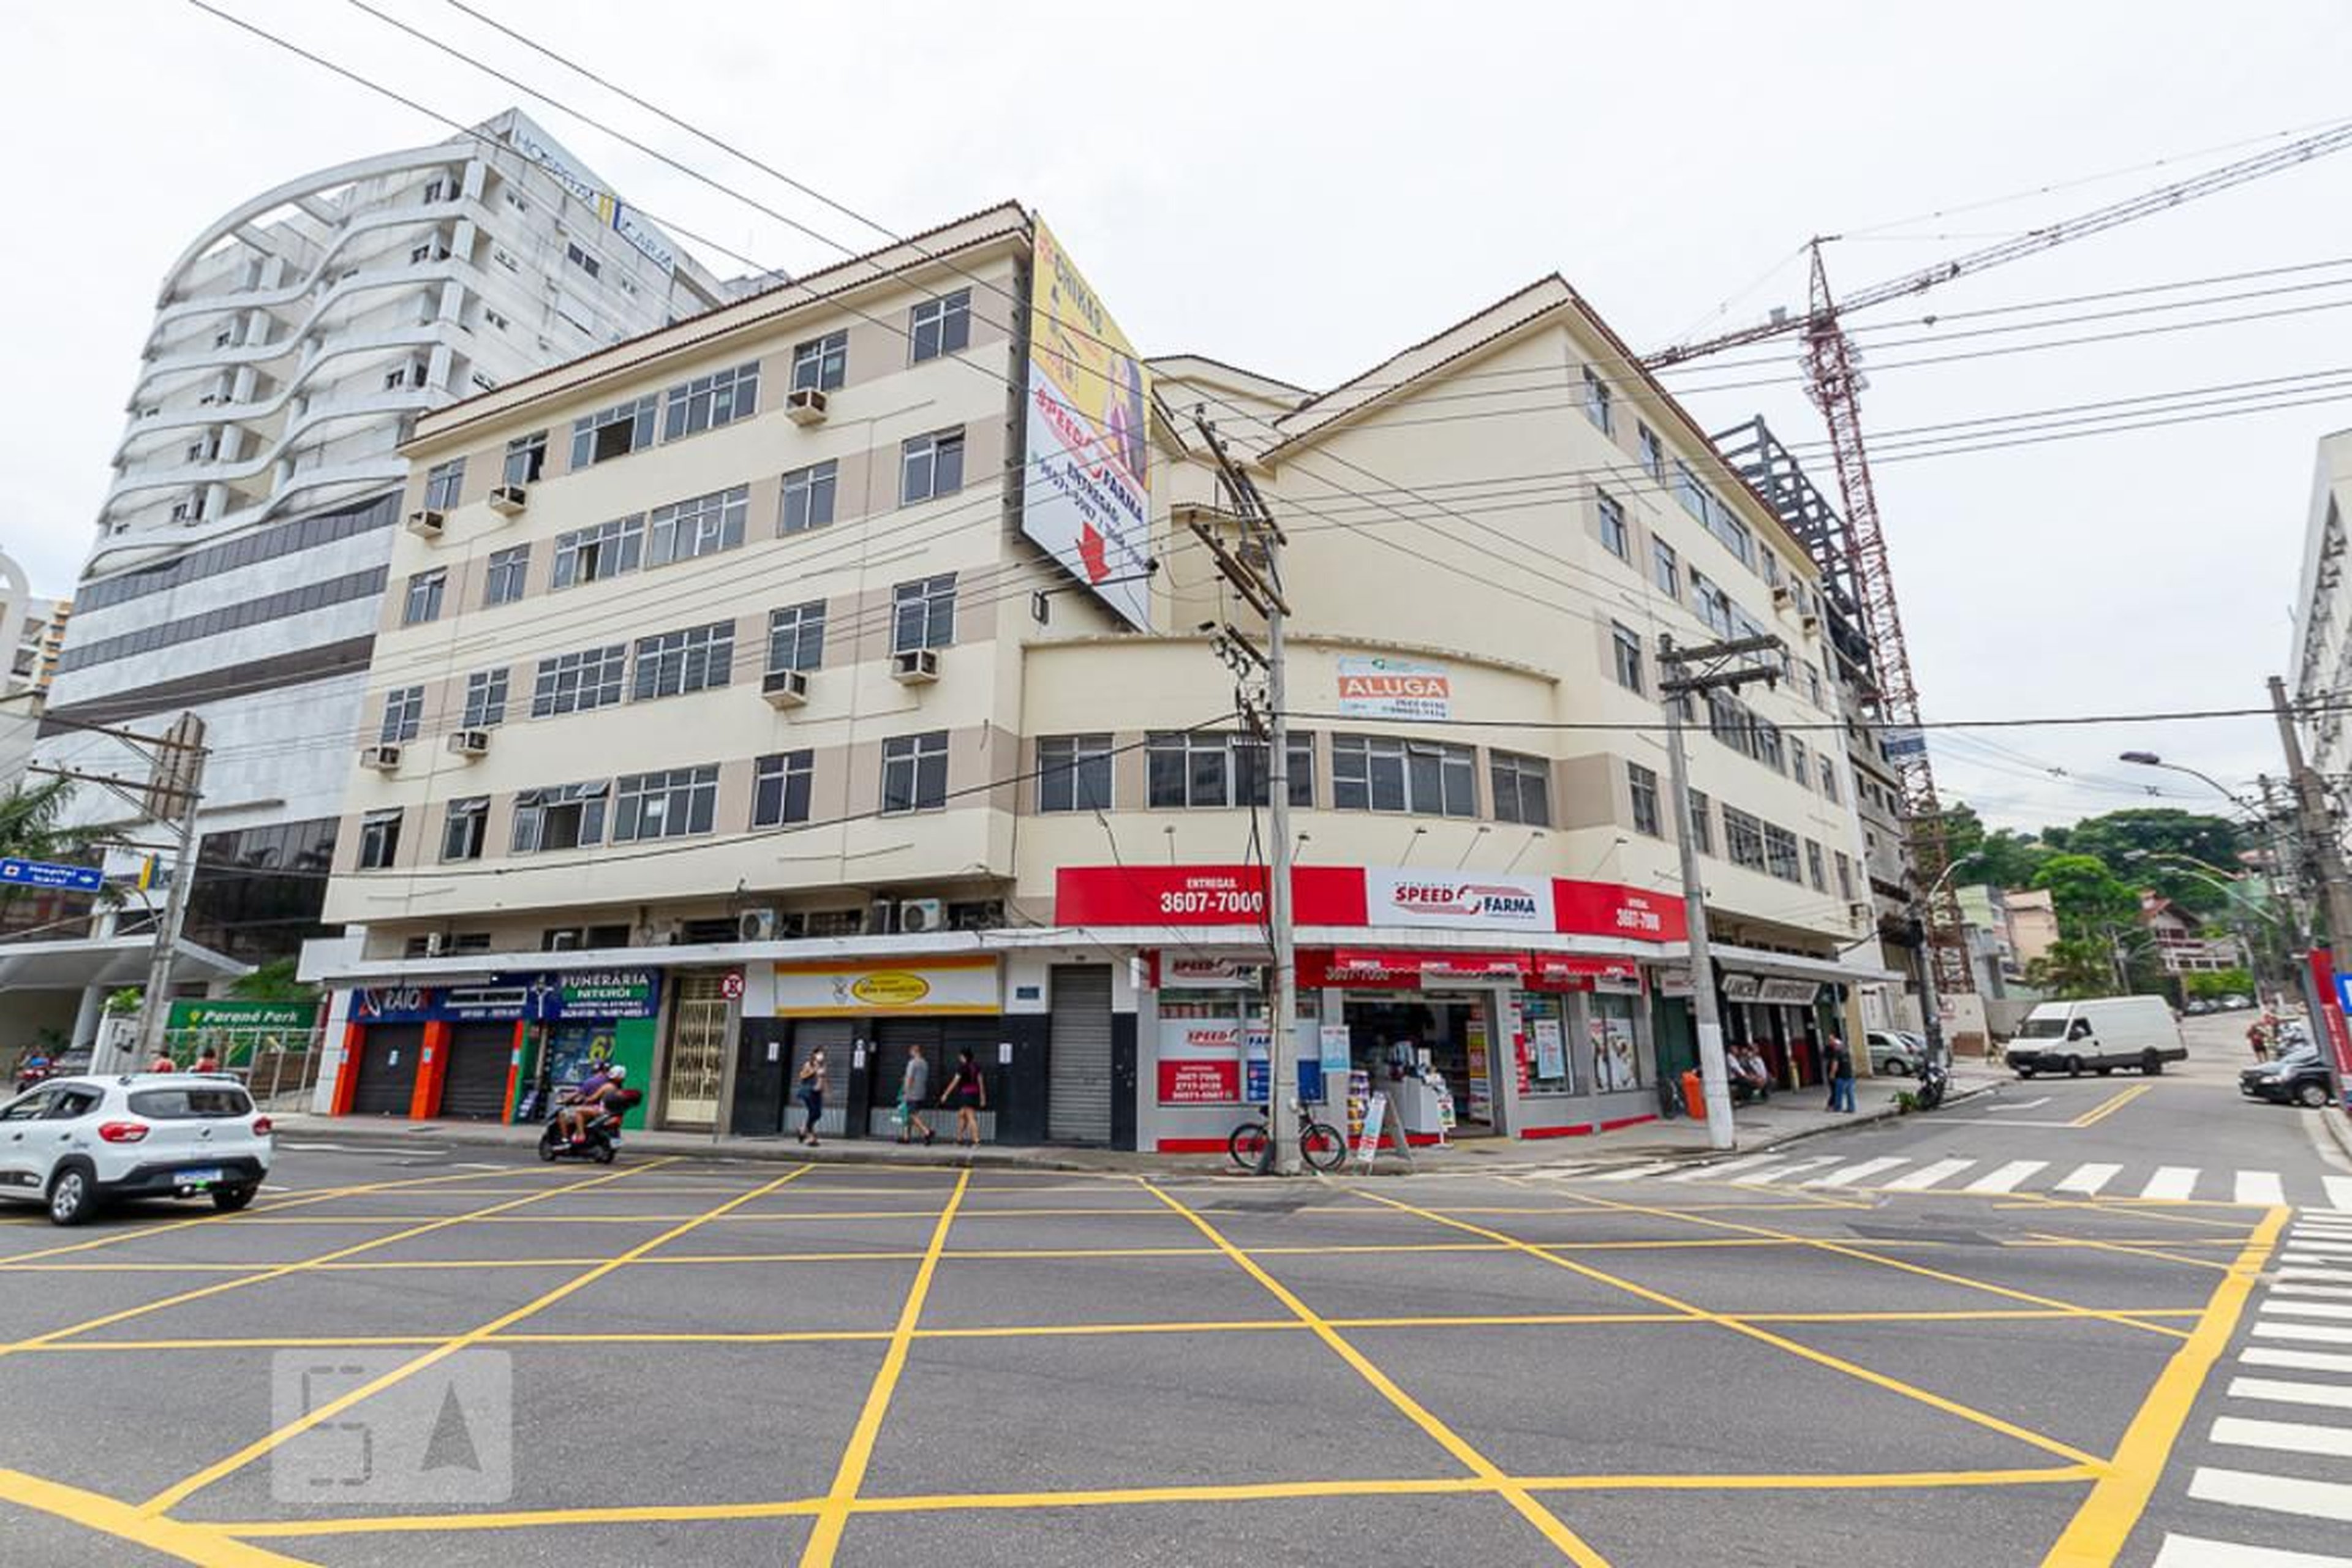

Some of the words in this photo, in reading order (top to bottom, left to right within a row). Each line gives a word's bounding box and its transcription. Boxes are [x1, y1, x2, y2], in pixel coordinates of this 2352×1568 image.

[1348, 678, 1446, 695] ALUGA
[1161, 891, 1264, 913] 3607-7000
[1395, 886, 1454, 903] SPEED
[1483, 896, 1536, 914] FARMA
